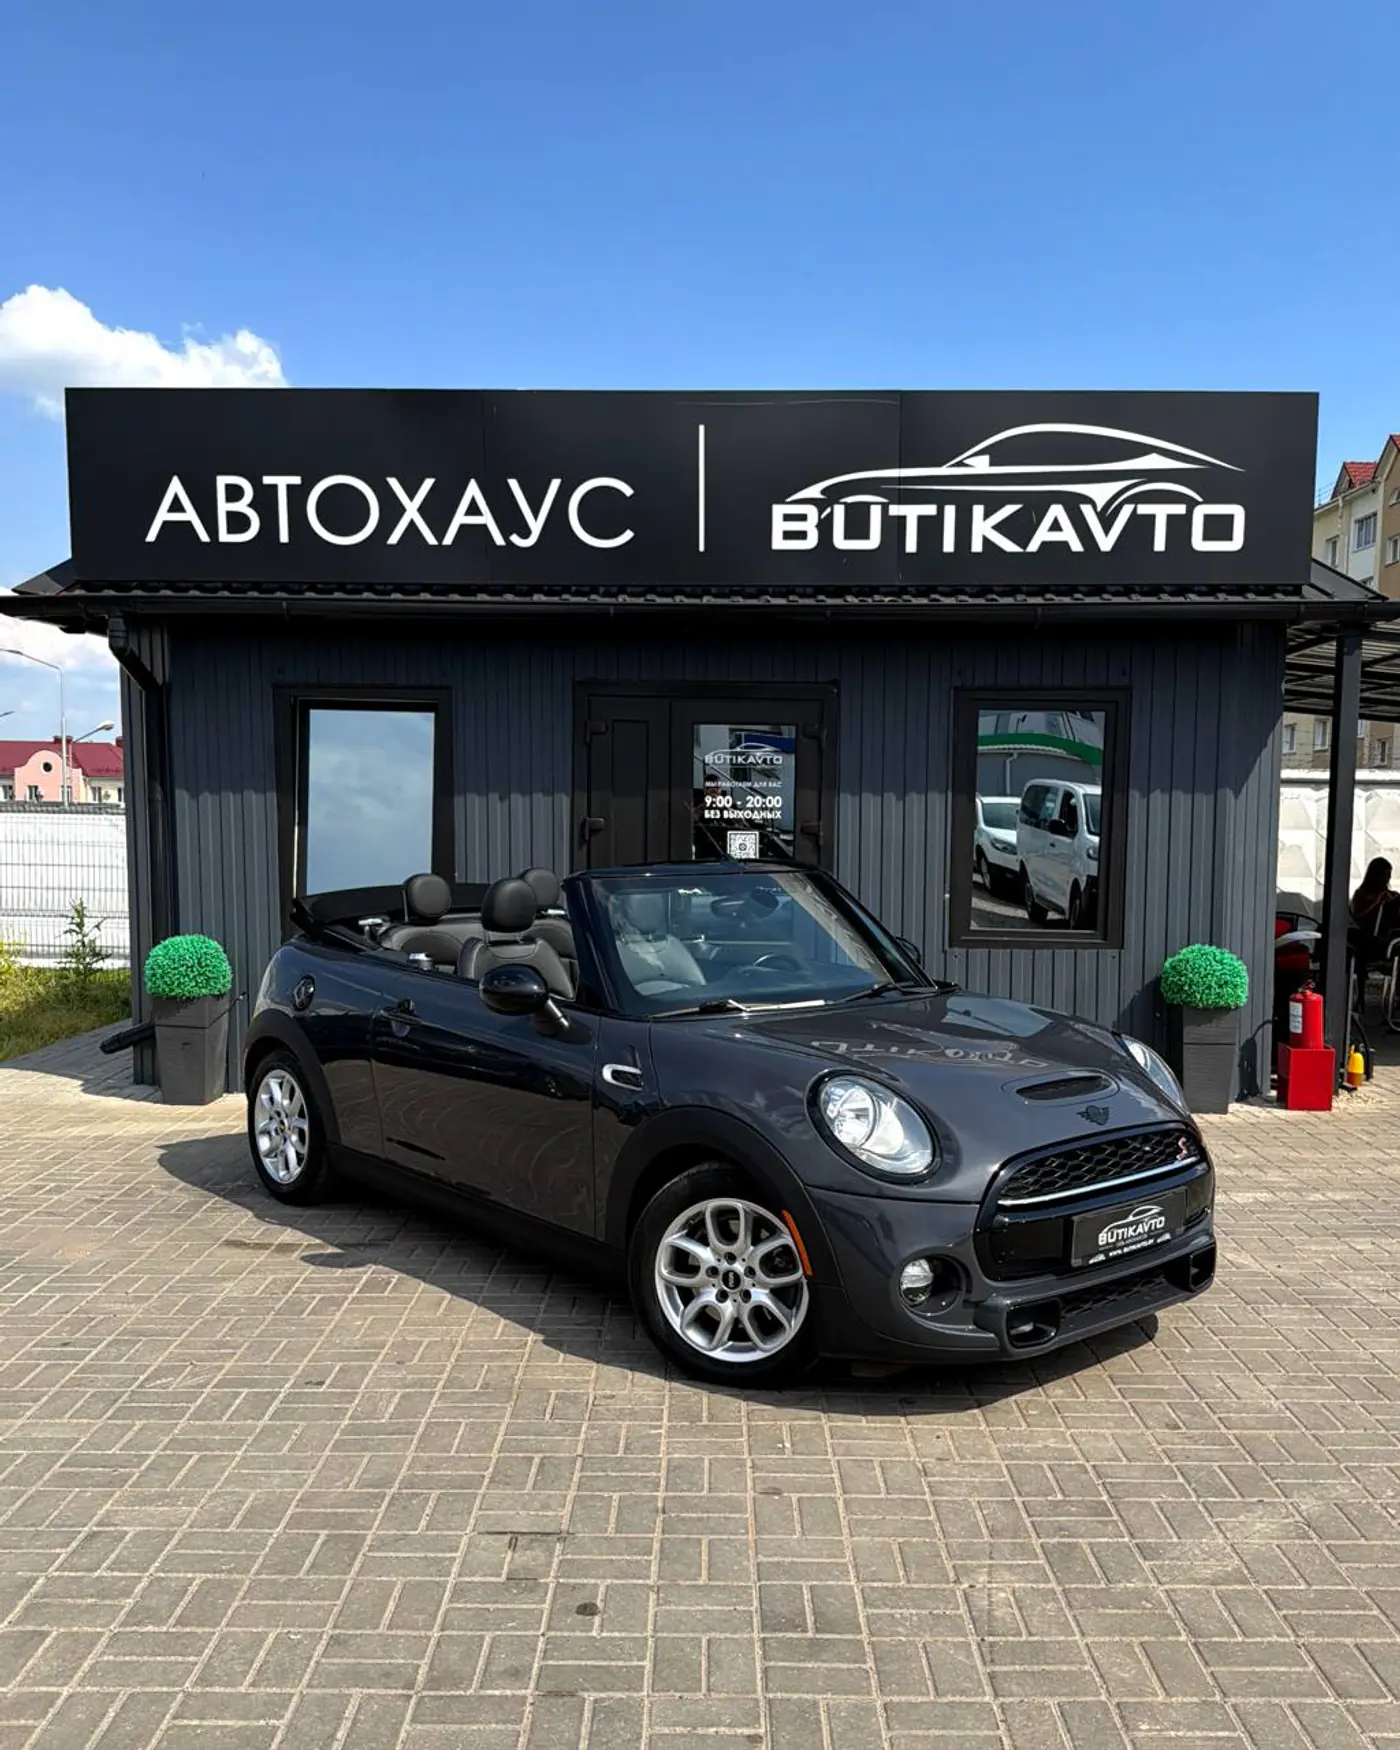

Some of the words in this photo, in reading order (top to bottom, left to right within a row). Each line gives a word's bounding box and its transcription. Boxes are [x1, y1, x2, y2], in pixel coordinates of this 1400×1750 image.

[144, 474, 635, 549] АВТОХАУС
[771, 503, 1246, 554] BUTIKAVTO
[704, 754, 783, 764] BUTIKAVTO
[704, 795, 733, 808] 9:00
[745, 795, 783, 808] 20:00
[704, 809, 721, 819] БЕЗ
[723, 809, 783, 819] ВЫХОДНЫХ
[1098, 1216, 1166, 1246] BUTIKAVTO
